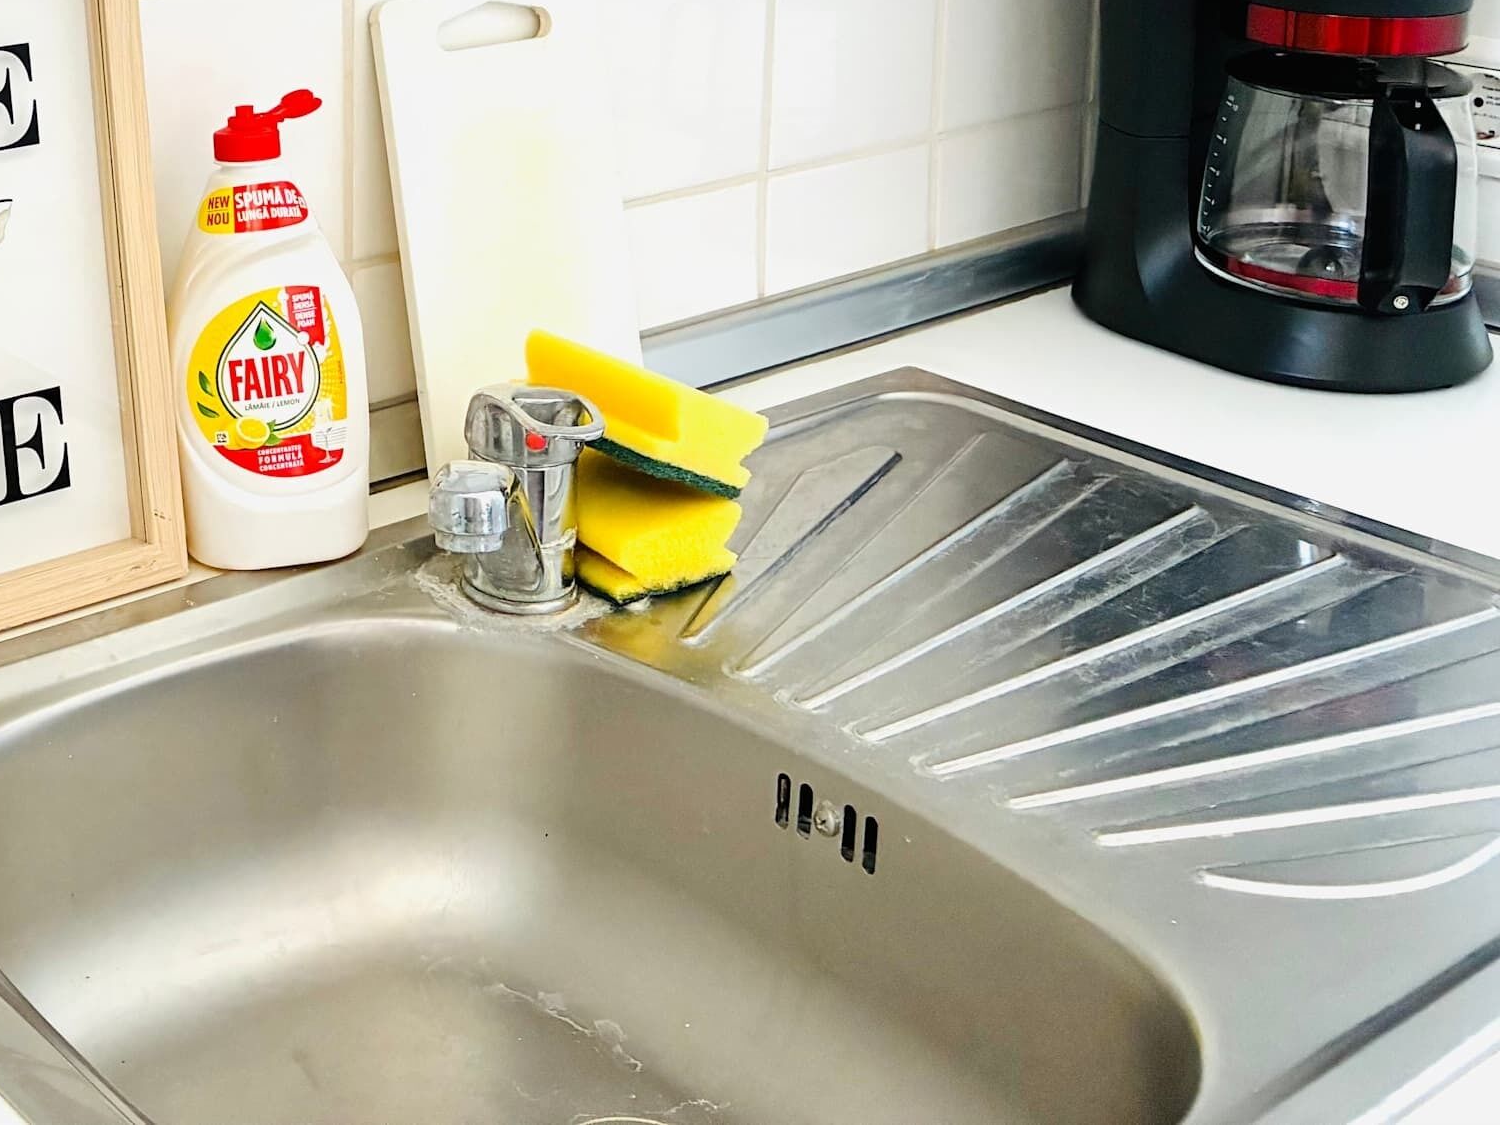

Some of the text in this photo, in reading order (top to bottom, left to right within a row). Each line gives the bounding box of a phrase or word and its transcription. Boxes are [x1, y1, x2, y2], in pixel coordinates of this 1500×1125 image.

[207, 195, 231, 211] NEW
[206, 211, 230, 226] NOU
[228, 351, 305, 402] FAIRY
